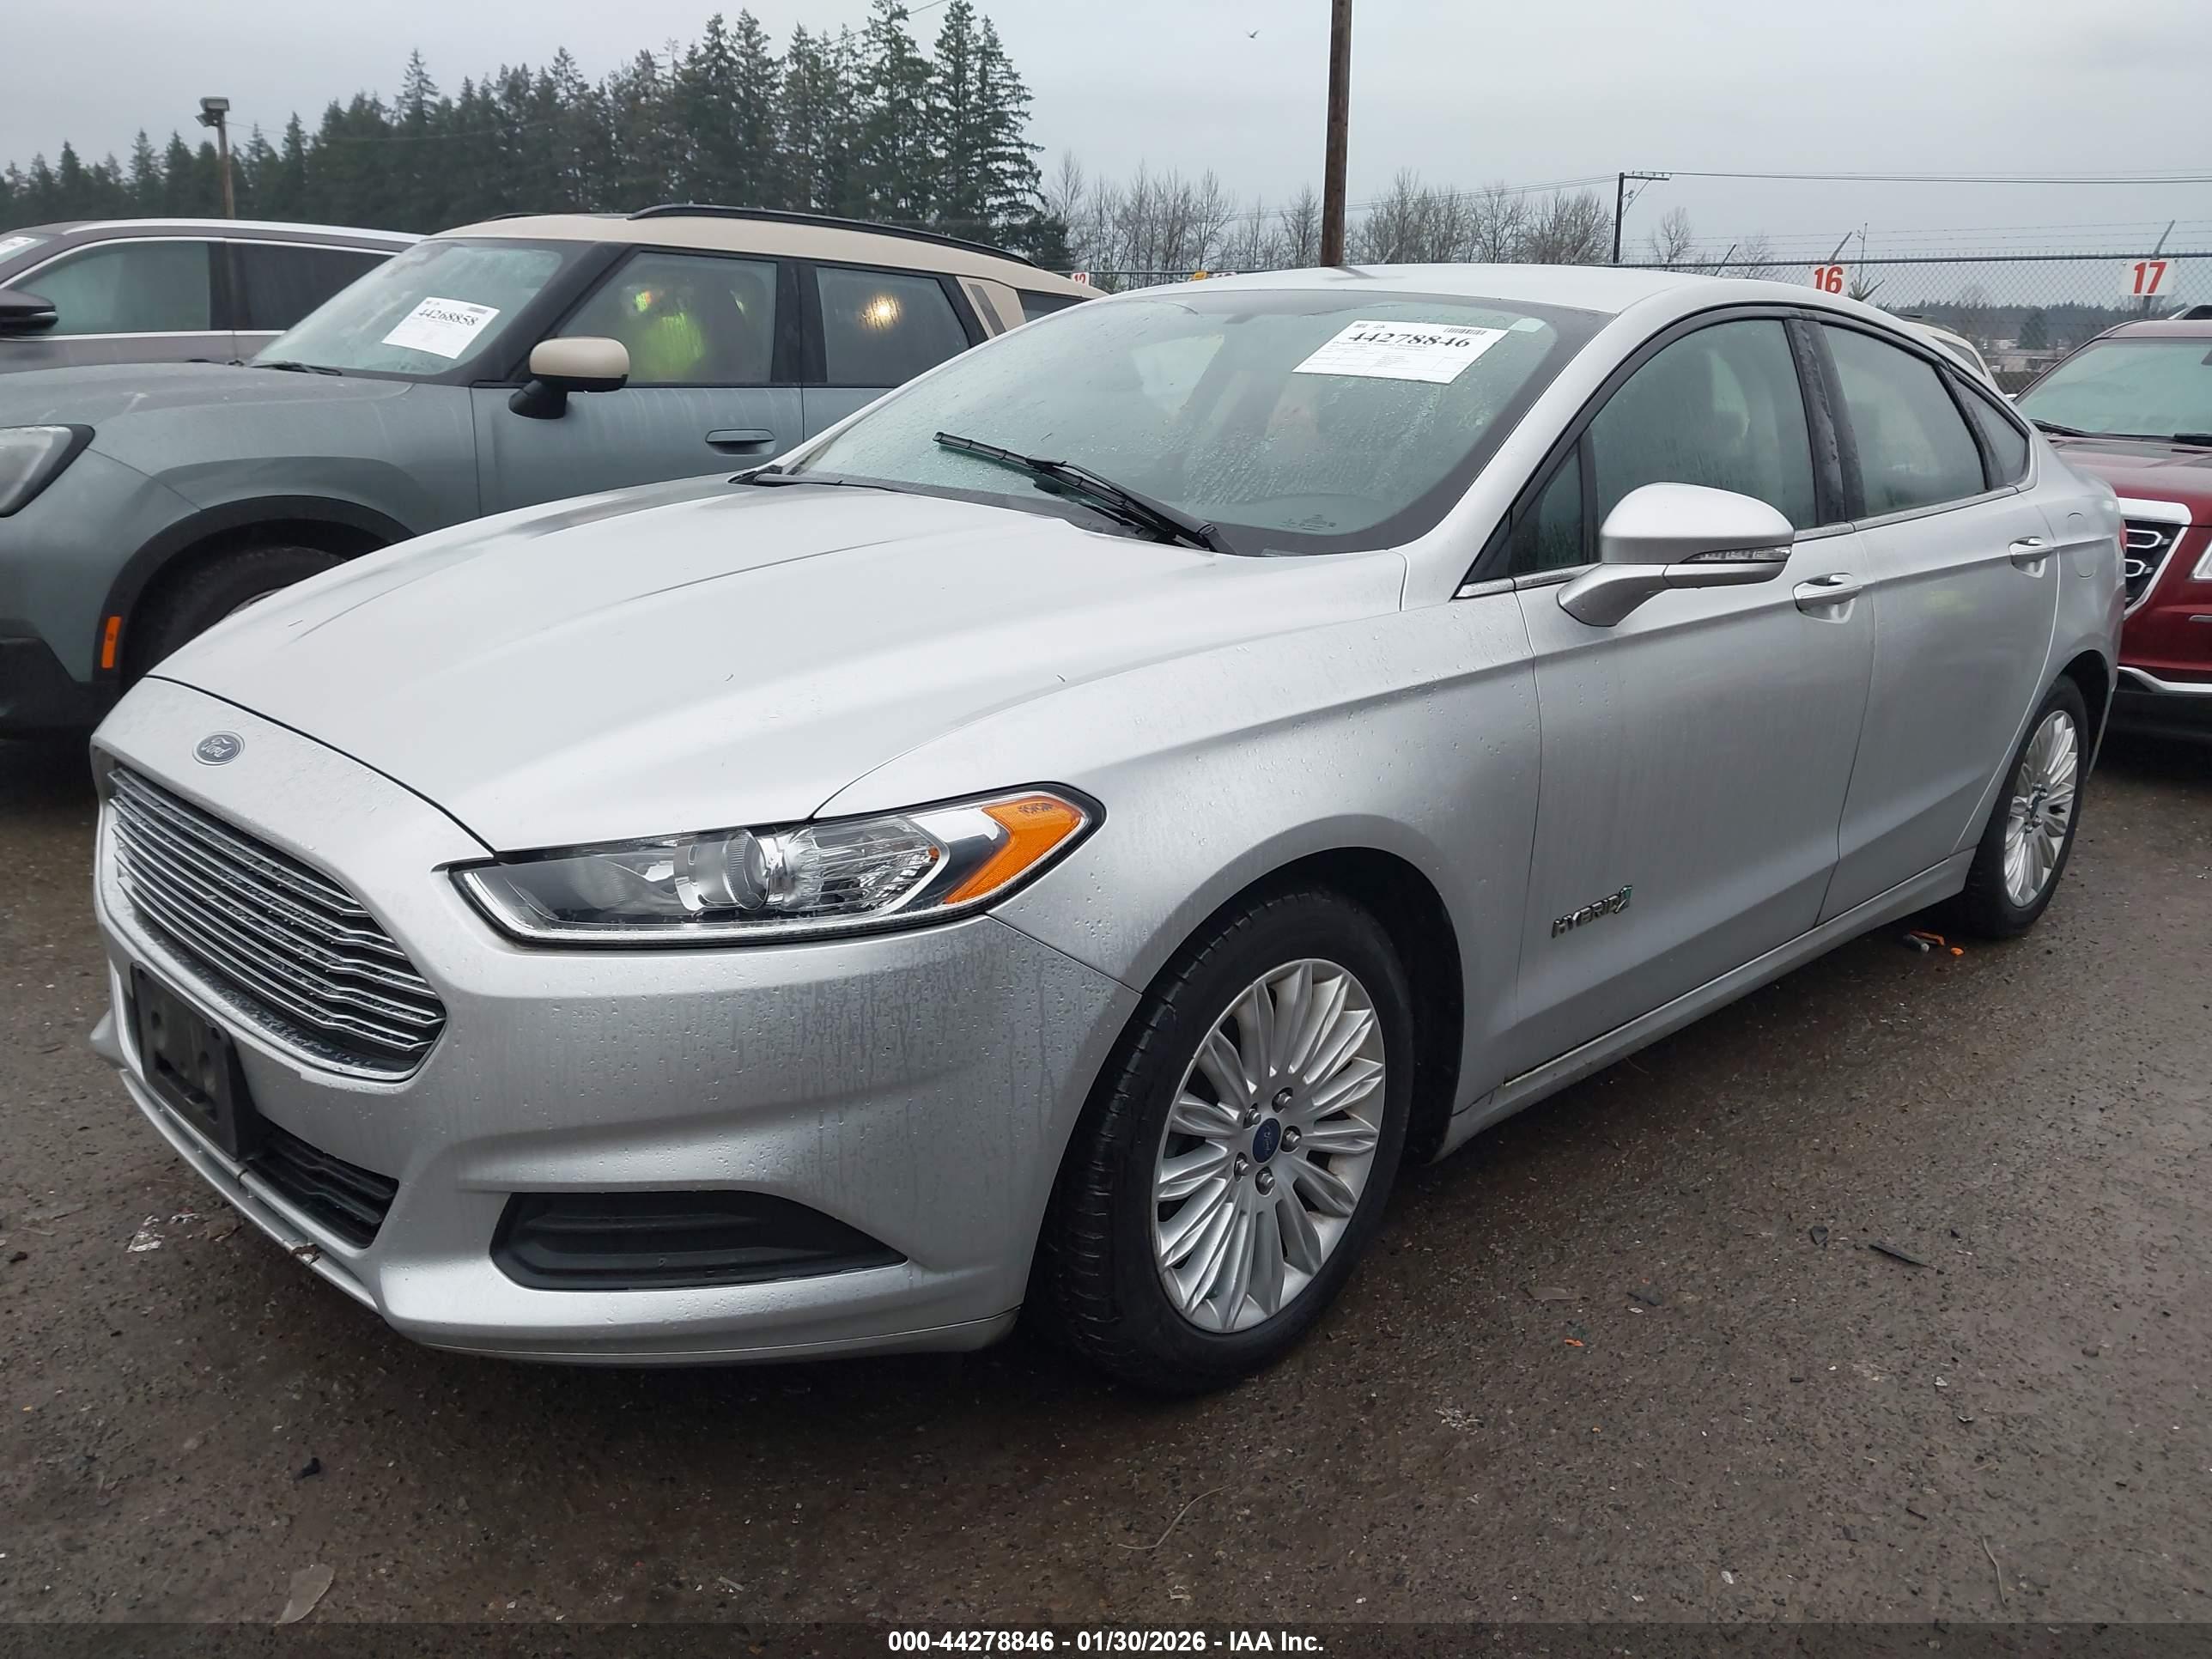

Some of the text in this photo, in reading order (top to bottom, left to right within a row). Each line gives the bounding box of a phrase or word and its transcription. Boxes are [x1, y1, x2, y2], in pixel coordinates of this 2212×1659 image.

[1814, 266, 1844, 294] 16
[2133, 261, 2166, 294] 17
[1348, 331, 1473, 347] 44278846
